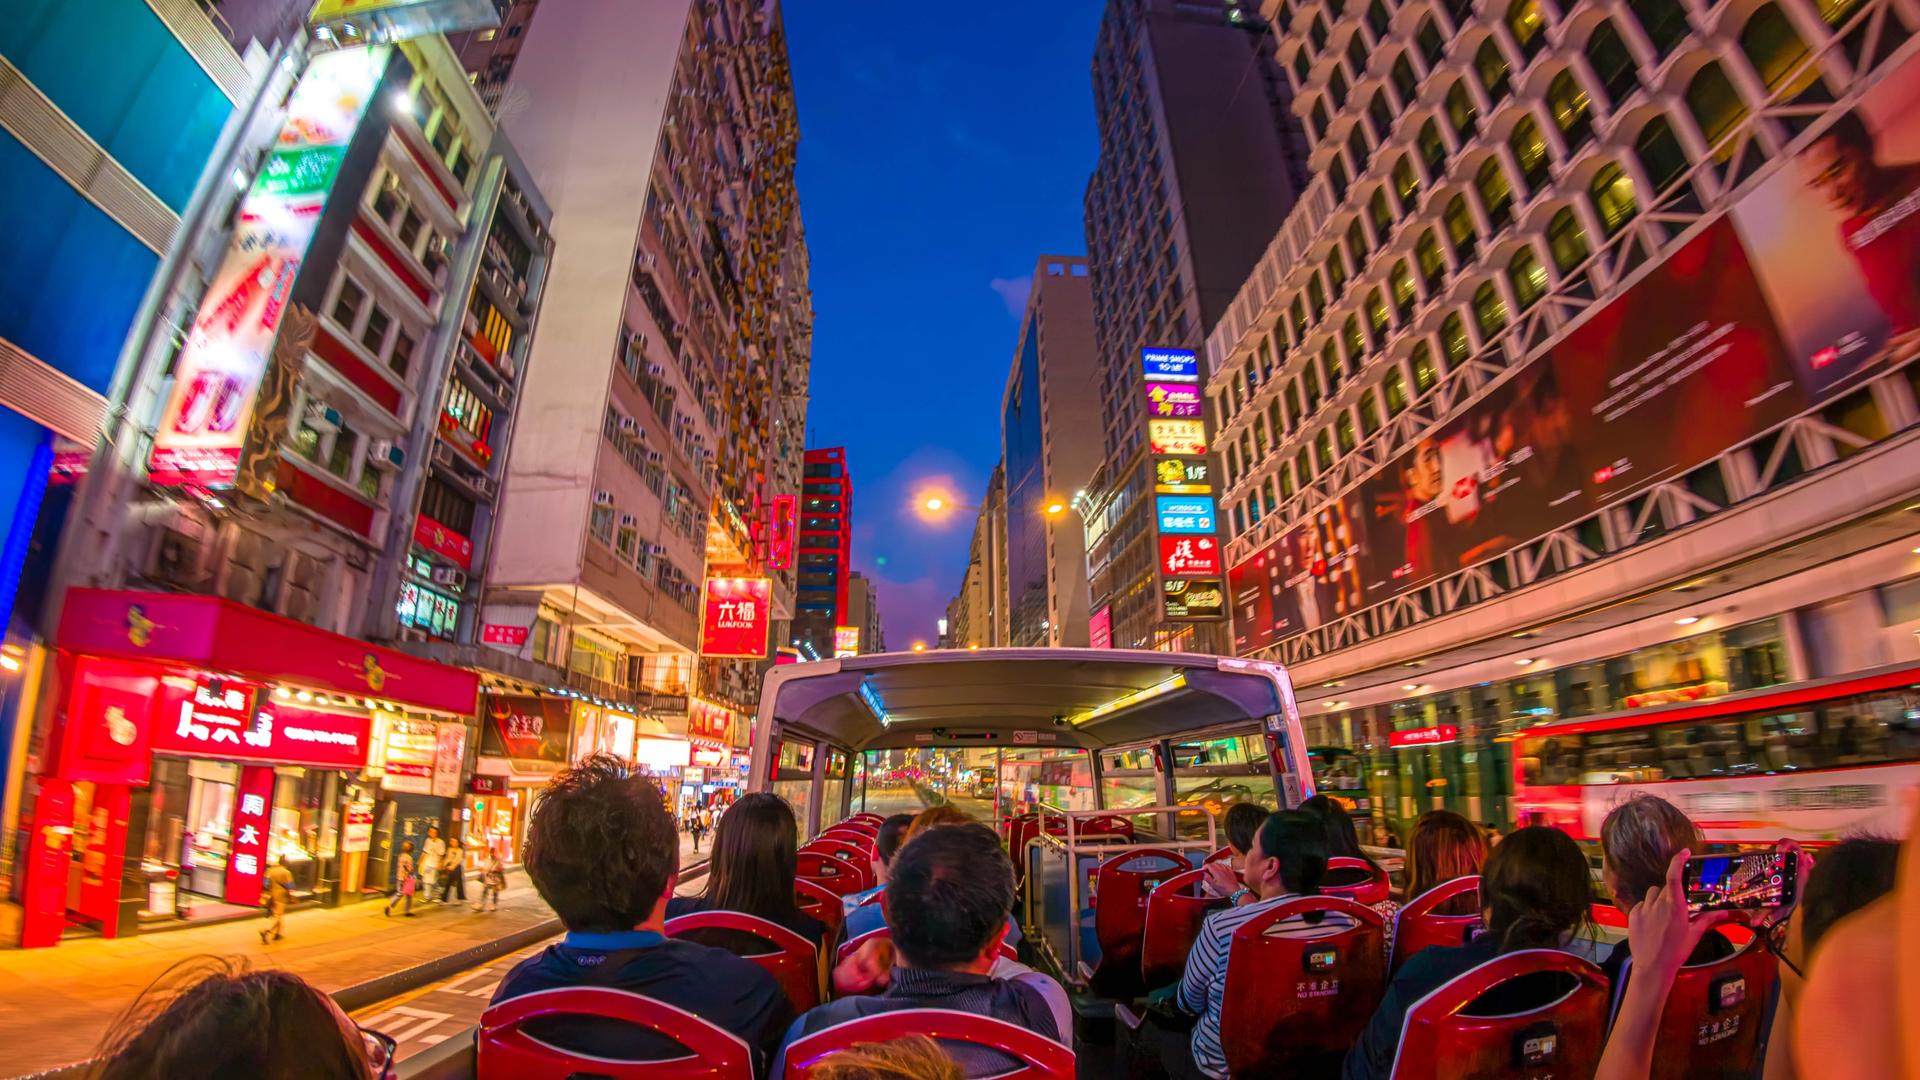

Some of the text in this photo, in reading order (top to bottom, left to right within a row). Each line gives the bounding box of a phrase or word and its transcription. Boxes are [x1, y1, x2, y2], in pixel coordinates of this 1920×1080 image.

[1185, 466, 1207, 480] 1/F
[1165, 580, 1185, 592] 5/F
[718, 601, 755, 621] 六福
[235, 793, 265, 876] 周大福
